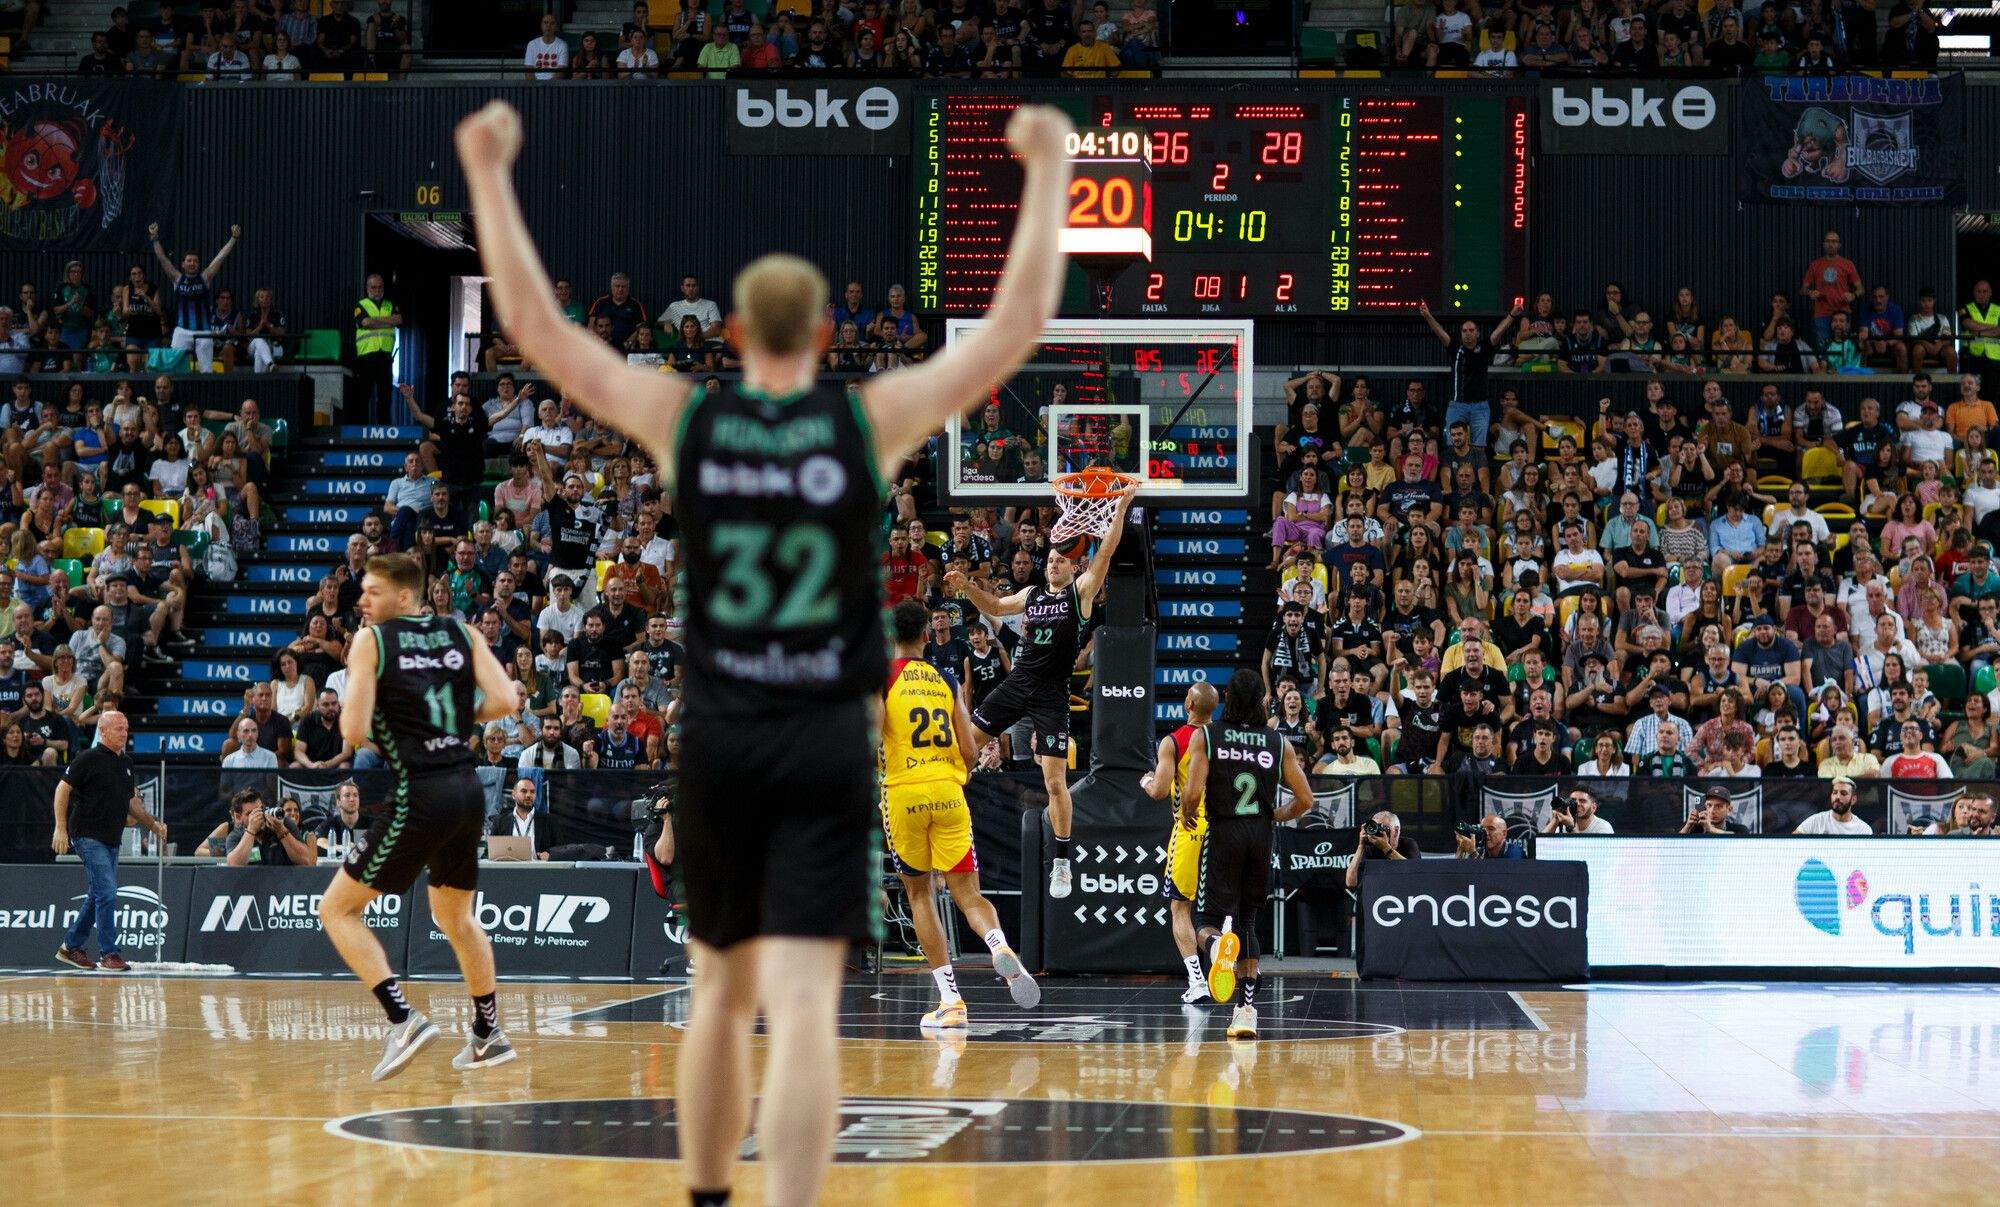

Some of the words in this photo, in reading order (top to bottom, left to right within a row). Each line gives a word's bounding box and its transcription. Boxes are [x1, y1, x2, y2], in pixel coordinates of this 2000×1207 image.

[0, 83, 104, 128] EABRUAK
[737, 89, 850, 127] bbk
[932, 99, 938, 109] E
[1343, 98, 1350, 109] E
[1552, 87, 1666, 126] bbk
[930, 113, 939, 126] 2
[1340, 113, 1350, 127] 0
[1515, 113, 1524, 127] 2
[930, 130, 939, 142] 5
[1515, 130, 1524, 144] 5
[1064, 132, 1139, 156] 04:10
[1152, 132, 1188, 164] 36
[1263, 132, 1302, 164] 28
[930, 146, 939, 159] 6
[1340, 146, 1350, 160] 2
[1515, 147, 1524, 161] 4
[930, 163, 939, 175] 7
[1340, 163, 1350, 177] 5
[1515, 163, 1524, 177] 3
[1213, 164, 1228, 190] 2
[930, 179, 939, 192] 8
[1342, 180, 1350, 193] 7
[1515, 180, 1524, 194] 2
[417, 186, 440, 205] 06
[920, 196, 938, 208] 11
[1068, 178, 1133, 224] 20
[1204, 193, 1238, 202] PERIODO
[1340, 196, 1350, 210] 8
[1515, 197, 1524, 211] 2
[1175, 210, 1266, 242] 04:10
[1340, 213, 1350, 227] 9
[1515, 213, 1524, 227] 2
[920, 229, 938, 242] 19
[1331, 230, 1349, 243] 11
[920, 245, 938, 258] 22
[1331, 246, 1349, 260] 23
[920, 262, 938, 275] 32
[1331, 263, 1349, 277] 30
[920, 279, 938, 292] 34
[1147, 274, 1163, 299] 2
[1194, 276, 1221, 298] 08
[1241, 276, 1247, 298] 1
[1276, 274, 1293, 300] 2
[1331, 280, 1349, 293] 34
[920, 295, 938, 308] 77
[1142, 304, 1168, 313] FALTAS
[1202, 304, 1221, 313] JUGA
[1275, 304, 1285, 313] AL
[1288, 304, 1297, 313] AS
[1331, 296, 1349, 310] 99
[362, 427, 399, 439] IMQ
[346, 454, 383, 466] IMQ
[963, 467, 978, 475] liga
[963, 474, 995, 482] endesa
[328, 481, 366, 494] IMQ
[309, 509, 348, 522] IMQ
[1182, 511, 1222, 524] IMQ
[290, 538, 330, 551] IMQ
[1178, 541, 1219, 554] IMQ
[271, 568, 311, 581] IMQ
[708, 522, 840, 629] 32
[1174, 572, 1216, 584] IMQ
[250, 600, 292, 614] IMQ
[1171, 602, 1214, 616] IMQ
[229, 632, 270, 646] IMQ
[1034, 628, 1053, 644] 22
[1167, 635, 1211, 650] IMQ
[207, 664, 250, 681] IMQ
[903, 670, 920, 682] DOS
[980, 666, 995, 681] 53
[1163, 669, 1207, 683] IMQ
[1102, 686, 1132, 697] bbk
[183, 700, 227, 715] IMQ
[425, 682, 459, 735] 11
[1156, 704, 1186, 718] IM
[909, 706, 953, 749] 23
[160, 735, 204, 750] IMQ
[1224, 729, 1267, 747] SMITH
[1217, 748, 1256, 763] bbk
[1233, 772, 1260, 816] 2
[1080, 873, 1135, 893] bbk
[268, 894, 401, 916] MEDNO
[1372, 884, 1578, 929] endesa
[0, 904, 55, 929] azul
[268, 915, 313, 930] Obras
[494, 933, 528, 946] Energy
[534, 935, 546, 947] by
[547, 936, 589, 947] Petronor
